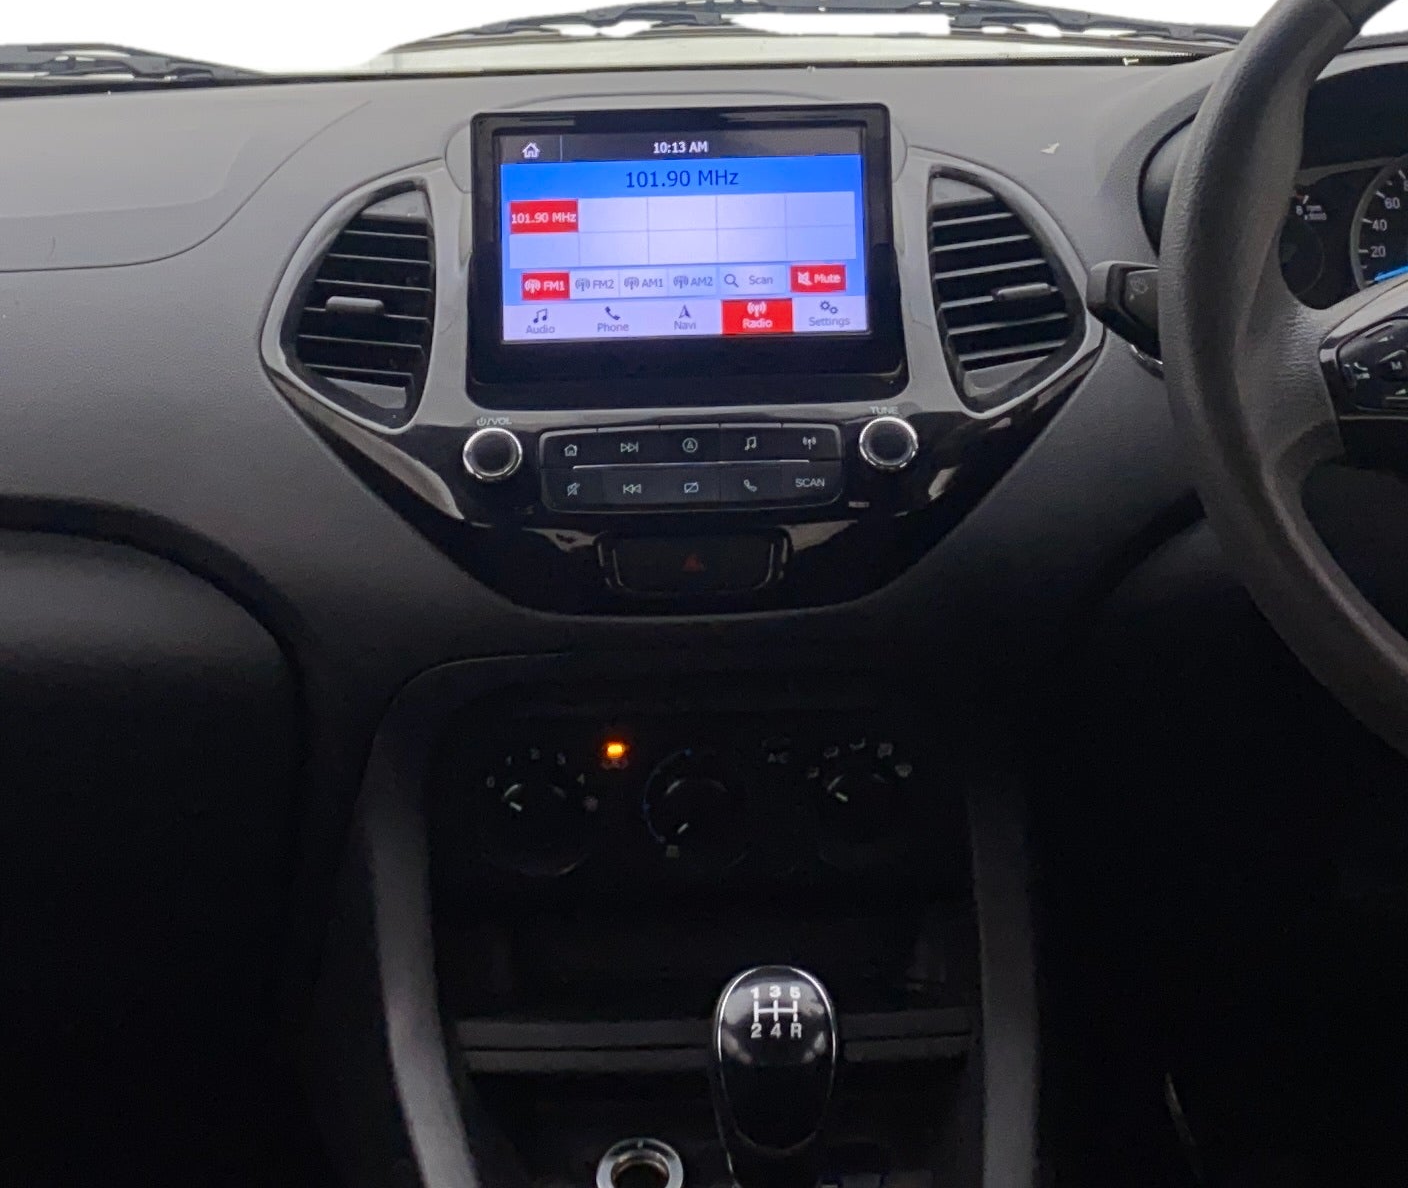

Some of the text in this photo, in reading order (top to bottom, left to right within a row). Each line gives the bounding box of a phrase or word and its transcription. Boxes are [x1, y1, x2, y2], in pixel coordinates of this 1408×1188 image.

[652, 140, 709, 154] 10:13 AM
[625, 169, 739, 188] 101.90 MHz
[1384, 197, 1401, 210] 60
[510, 211, 577, 224] 101.90 MHz
[1371, 220, 1388, 233] 40
[1370, 245, 1386, 258] 20
[641, 277, 664, 289] AM1
[690, 275, 713, 287] AM2
[748, 274, 774, 286] Scan
[814, 272, 841, 284] Mute
[542, 280, 565, 292] FM1
[592, 279, 615, 291] FM2
[597, 321, 629, 333] Phone
[674, 319, 696, 330] Navi
[742, 317, 773, 329] Radio
[808, 314, 850, 329] Settings
[525, 323, 555, 335] Audio
[870, 405, 899, 415] TUNE
[794, 477, 825, 488] SCAN
[750, 987, 759, 999] 1
[769, 985, 781, 998] 3
[751, 1023, 802, 1039] 2 4 R
